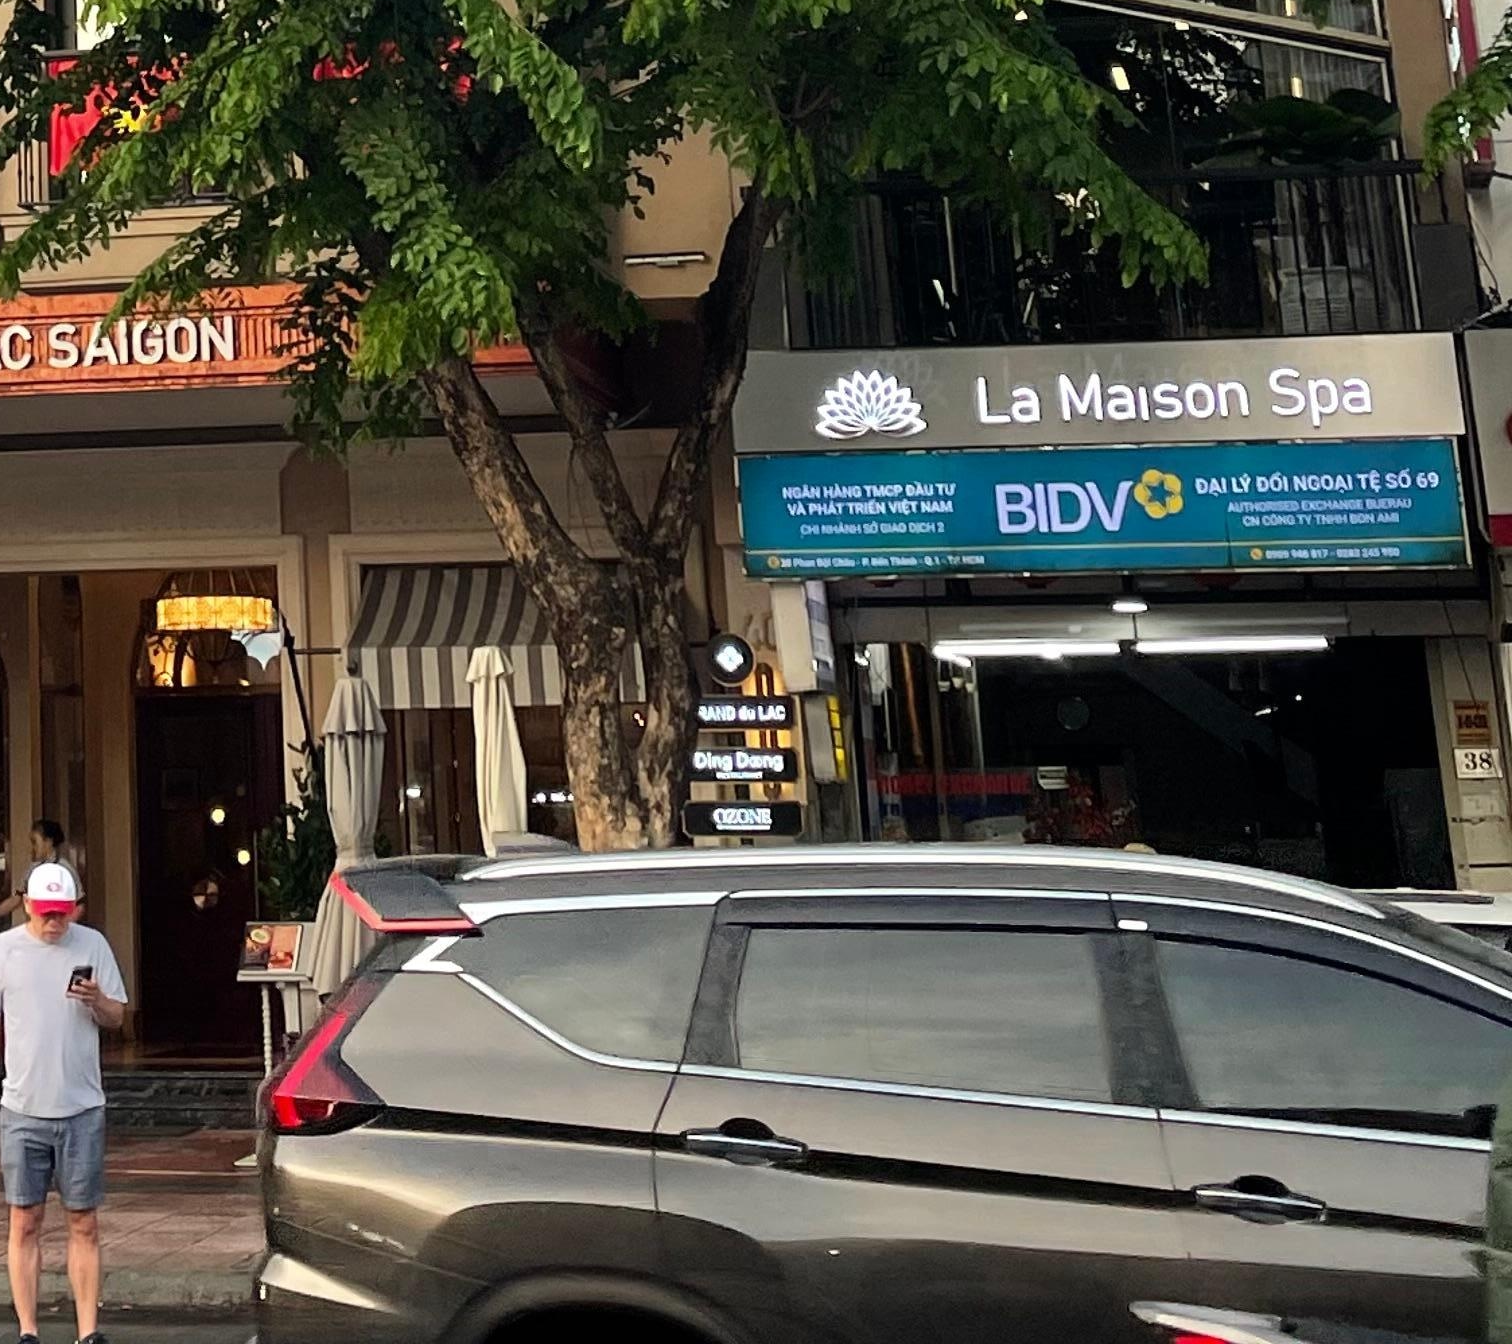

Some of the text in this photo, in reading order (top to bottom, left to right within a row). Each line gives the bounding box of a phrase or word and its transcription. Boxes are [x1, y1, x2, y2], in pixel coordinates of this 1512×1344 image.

[47, 316, 236, 369] SAIGON
[976, 367, 1373, 427] La Maison Spa
[864, 484, 903, 498] TMCP
[1195, 475, 1227, 496] ĐẠI
[1231, 473, 1251, 493] LÝ
[1293, 472, 1353, 494] NGOẠI
[1356, 470, 1381, 493] TỆ
[1385, 468, 1412, 489] SỐ
[1416, 471, 1440, 489] 69
[921, 500, 954, 513] NAM
[995, 480, 1134, 534] BIDV
[698, 704, 736, 722] RAND
[758, 705, 786, 722] LAC
[693, 751, 733, 772] Ding
[1464, 752, 1492, 770] 38
[713, 808, 772, 825] OZONE
